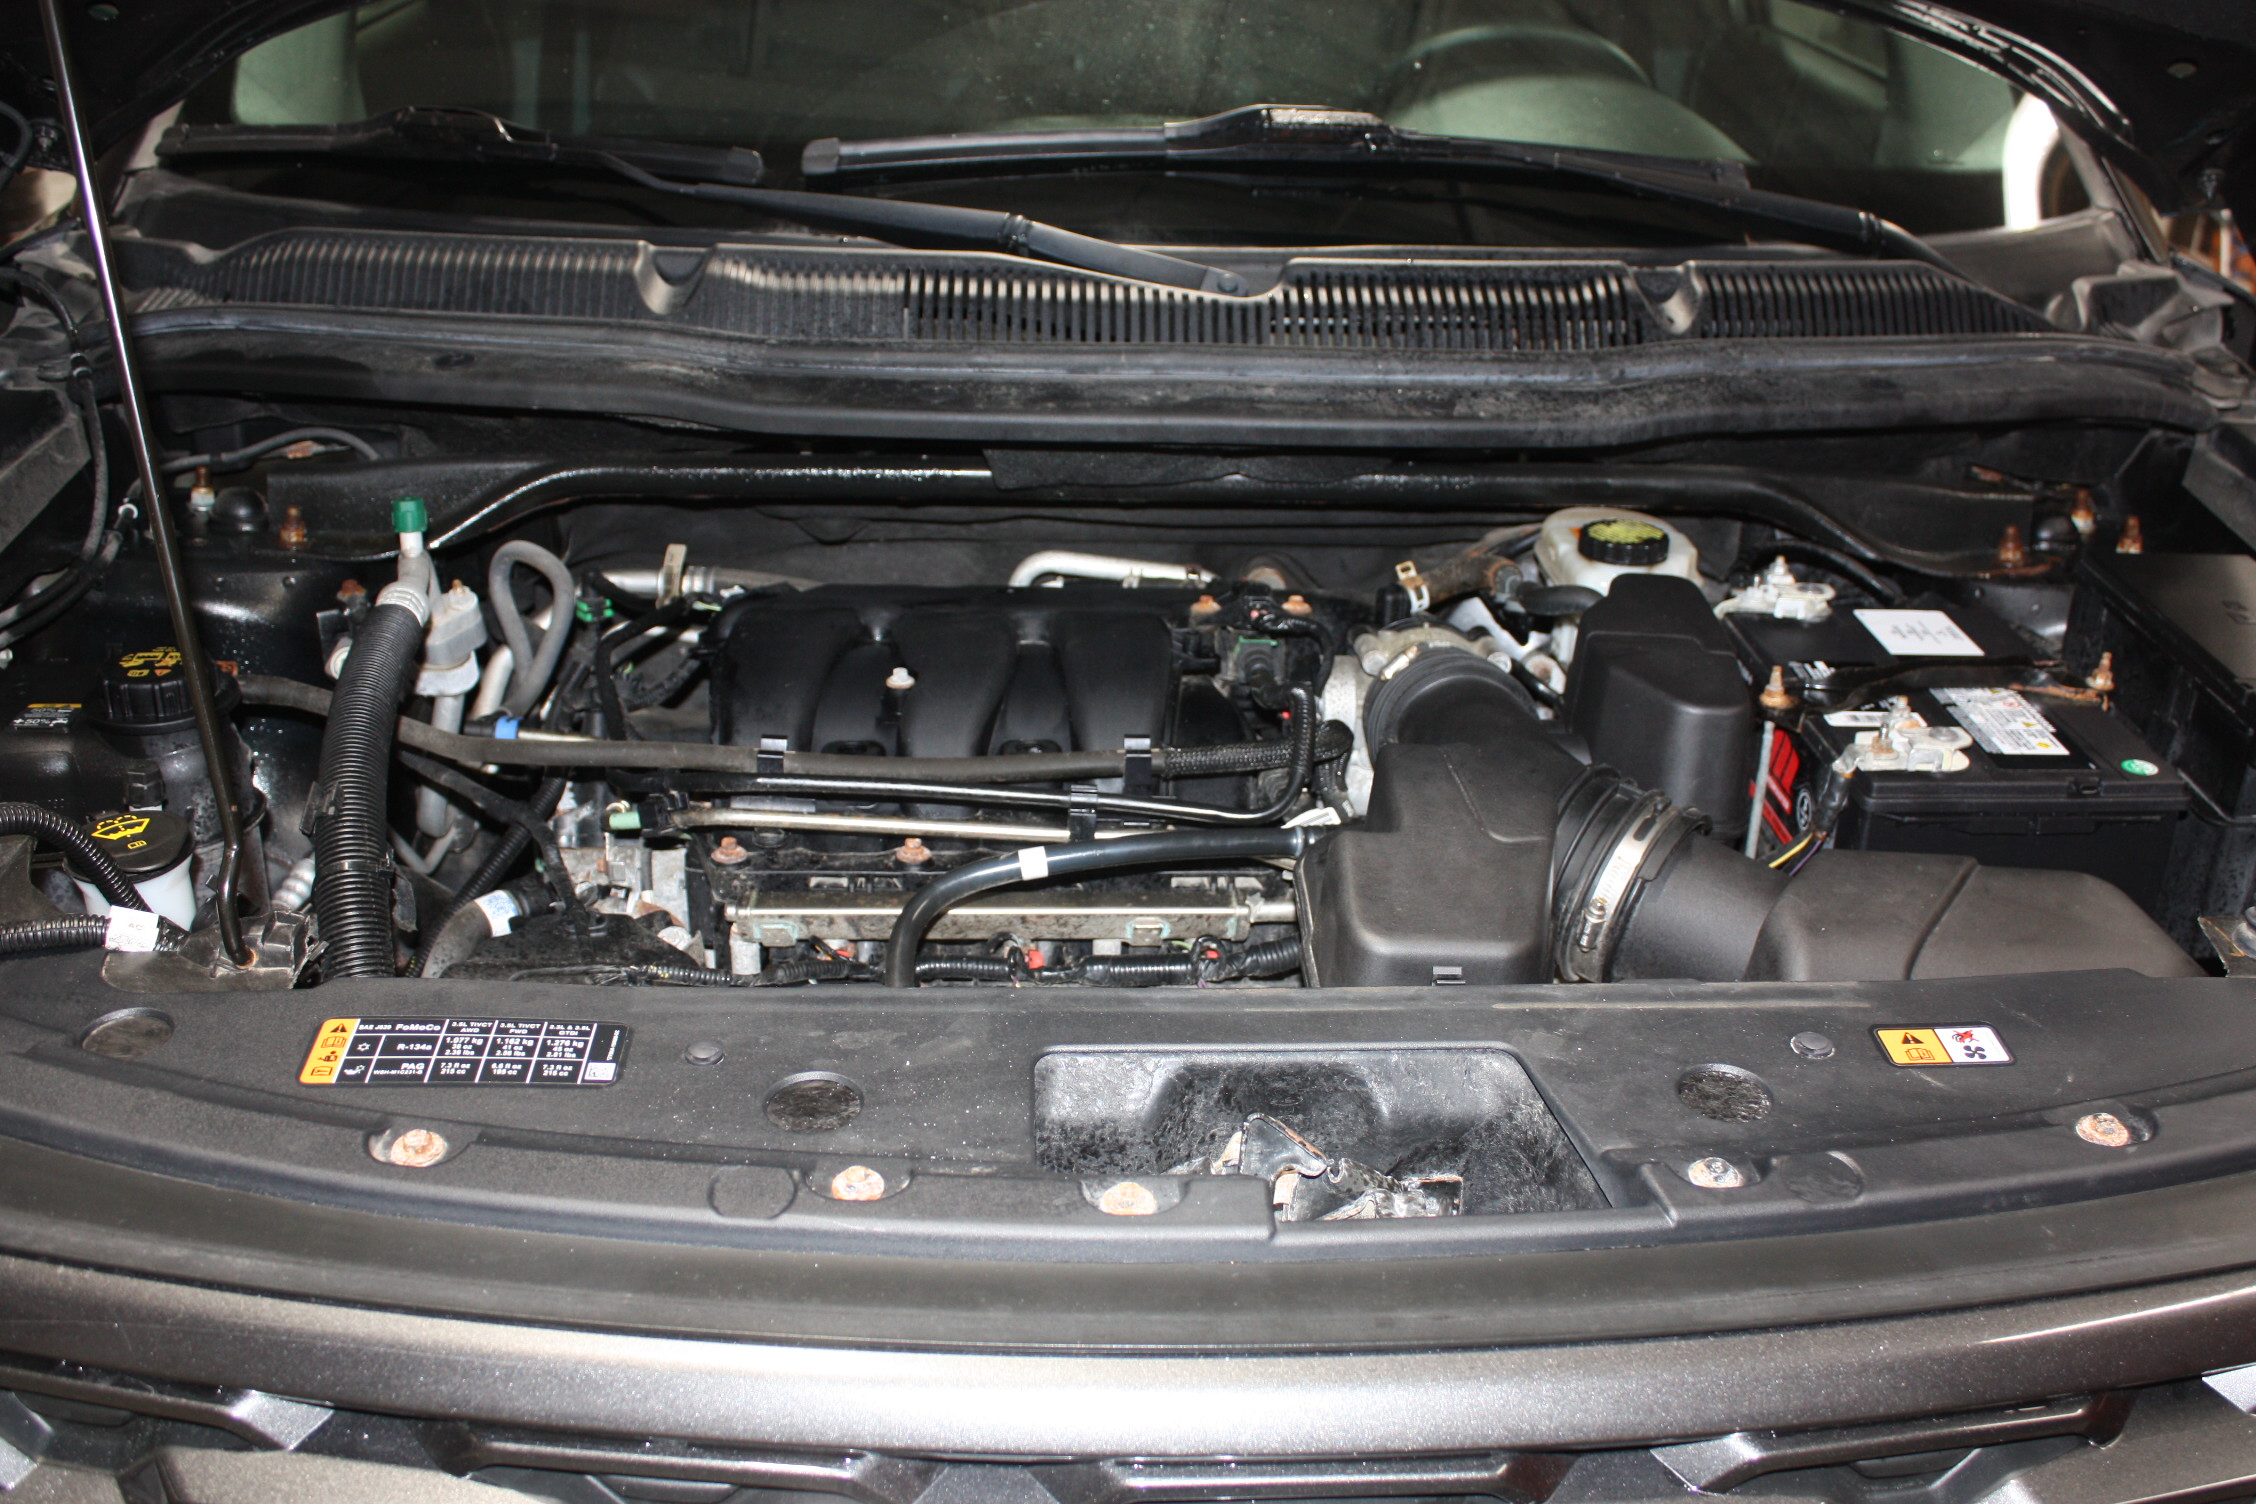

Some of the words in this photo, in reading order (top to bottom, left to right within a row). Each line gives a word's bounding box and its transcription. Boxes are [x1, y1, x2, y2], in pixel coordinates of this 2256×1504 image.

[395, 1023, 441, 1031] FoMoCo
[471, 1037, 484, 1045] kg
[521, 1038, 534, 1046] kg
[572, 1040, 585, 1048] kg
[396, 1043, 432, 1051] R-134a
